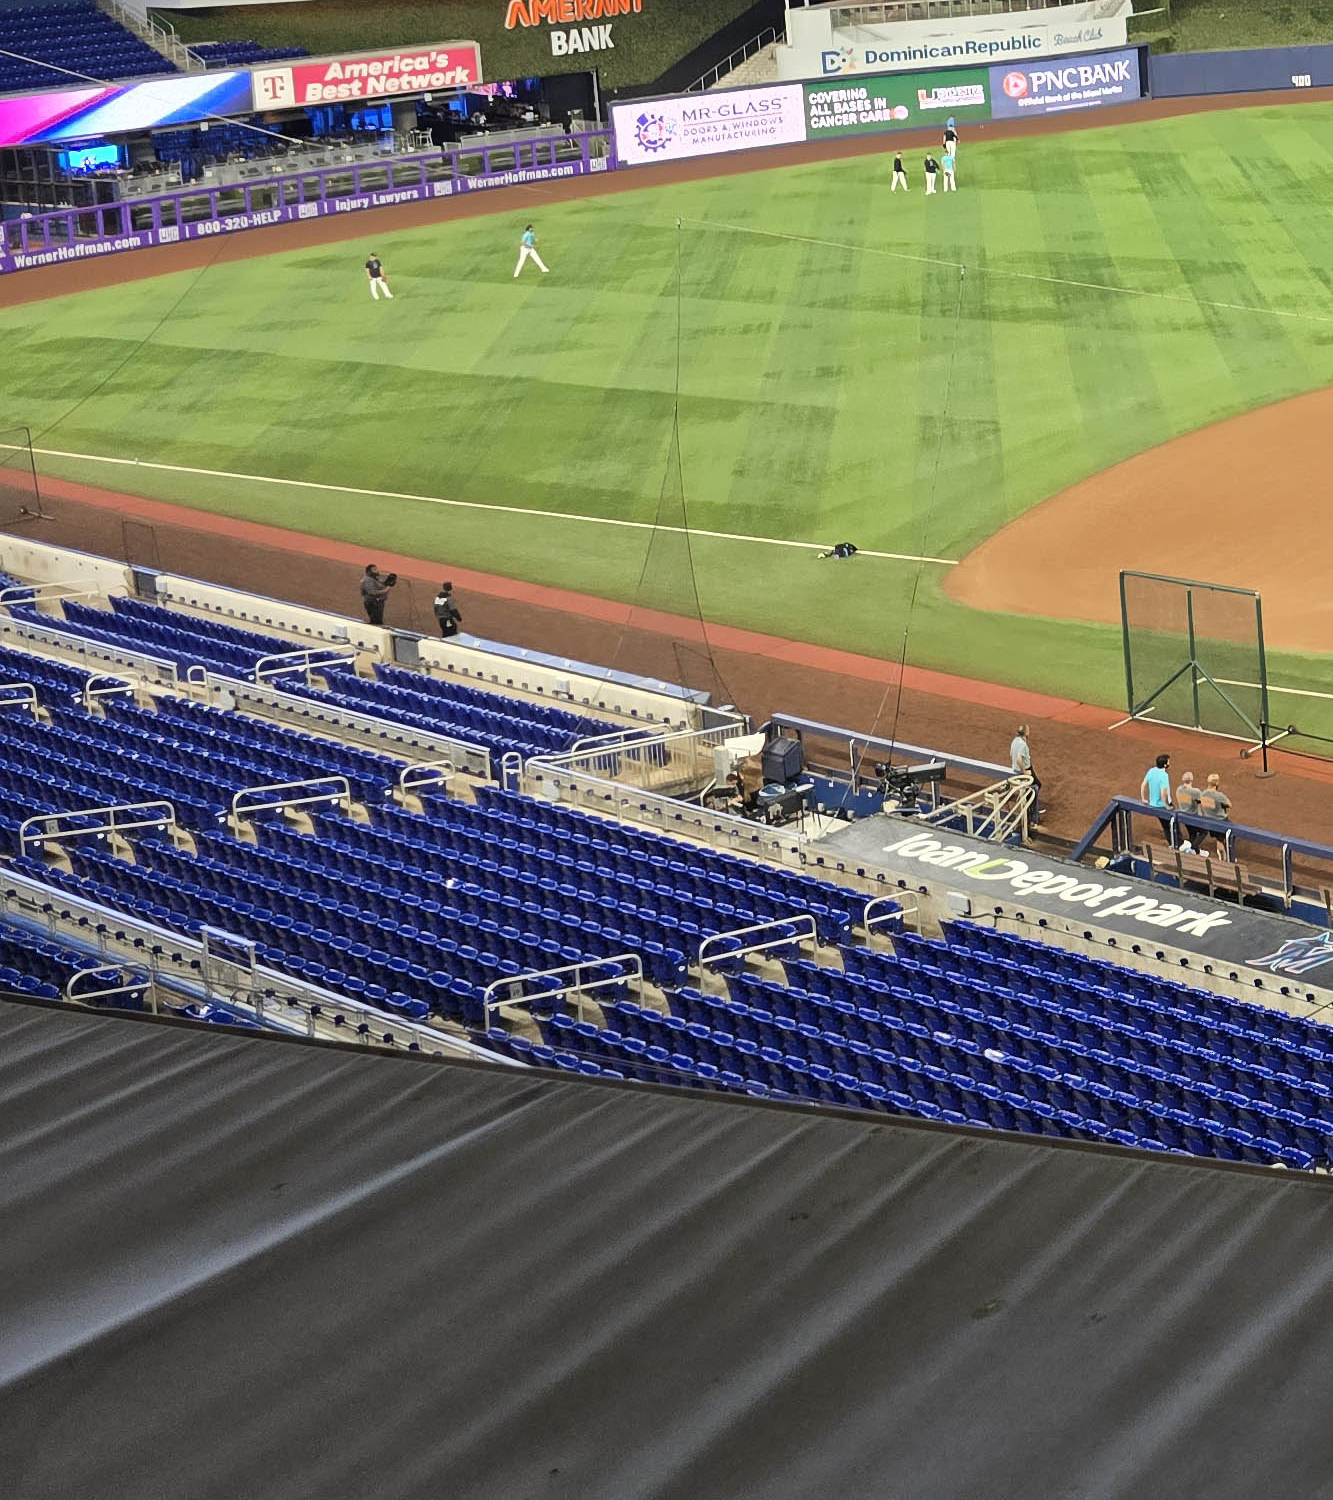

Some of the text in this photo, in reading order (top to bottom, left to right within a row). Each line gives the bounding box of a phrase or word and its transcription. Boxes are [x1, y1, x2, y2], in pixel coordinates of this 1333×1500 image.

[550, 23, 615, 57] BANK
[324, 52, 450, 81] America's
[304, 66, 470, 102] Best Network
[1291, 74, 1312, 88] 400
[808, 87, 868, 105] COVERING
[810, 97, 887, 117] ALL BASES IN
[682, 98, 782, 122] MR-GLASS
[810, 108, 891, 129] CANCER CARE
[683, 126, 720, 137] DOORS
[733, 117, 784, 132] WINDOWS
[692, 127, 777, 145] MANUFACTURING
[467, 165, 574, 189] WernerHoffman.com
[335, 197, 370, 212] Injury
[372, 190, 420, 206] Lawyers
[197, 210, 282, 235] 800-320-HELP
[14, 236, 141, 268] WernerHoffman.com
[883, 832, 1232, 938] loanDepot park
